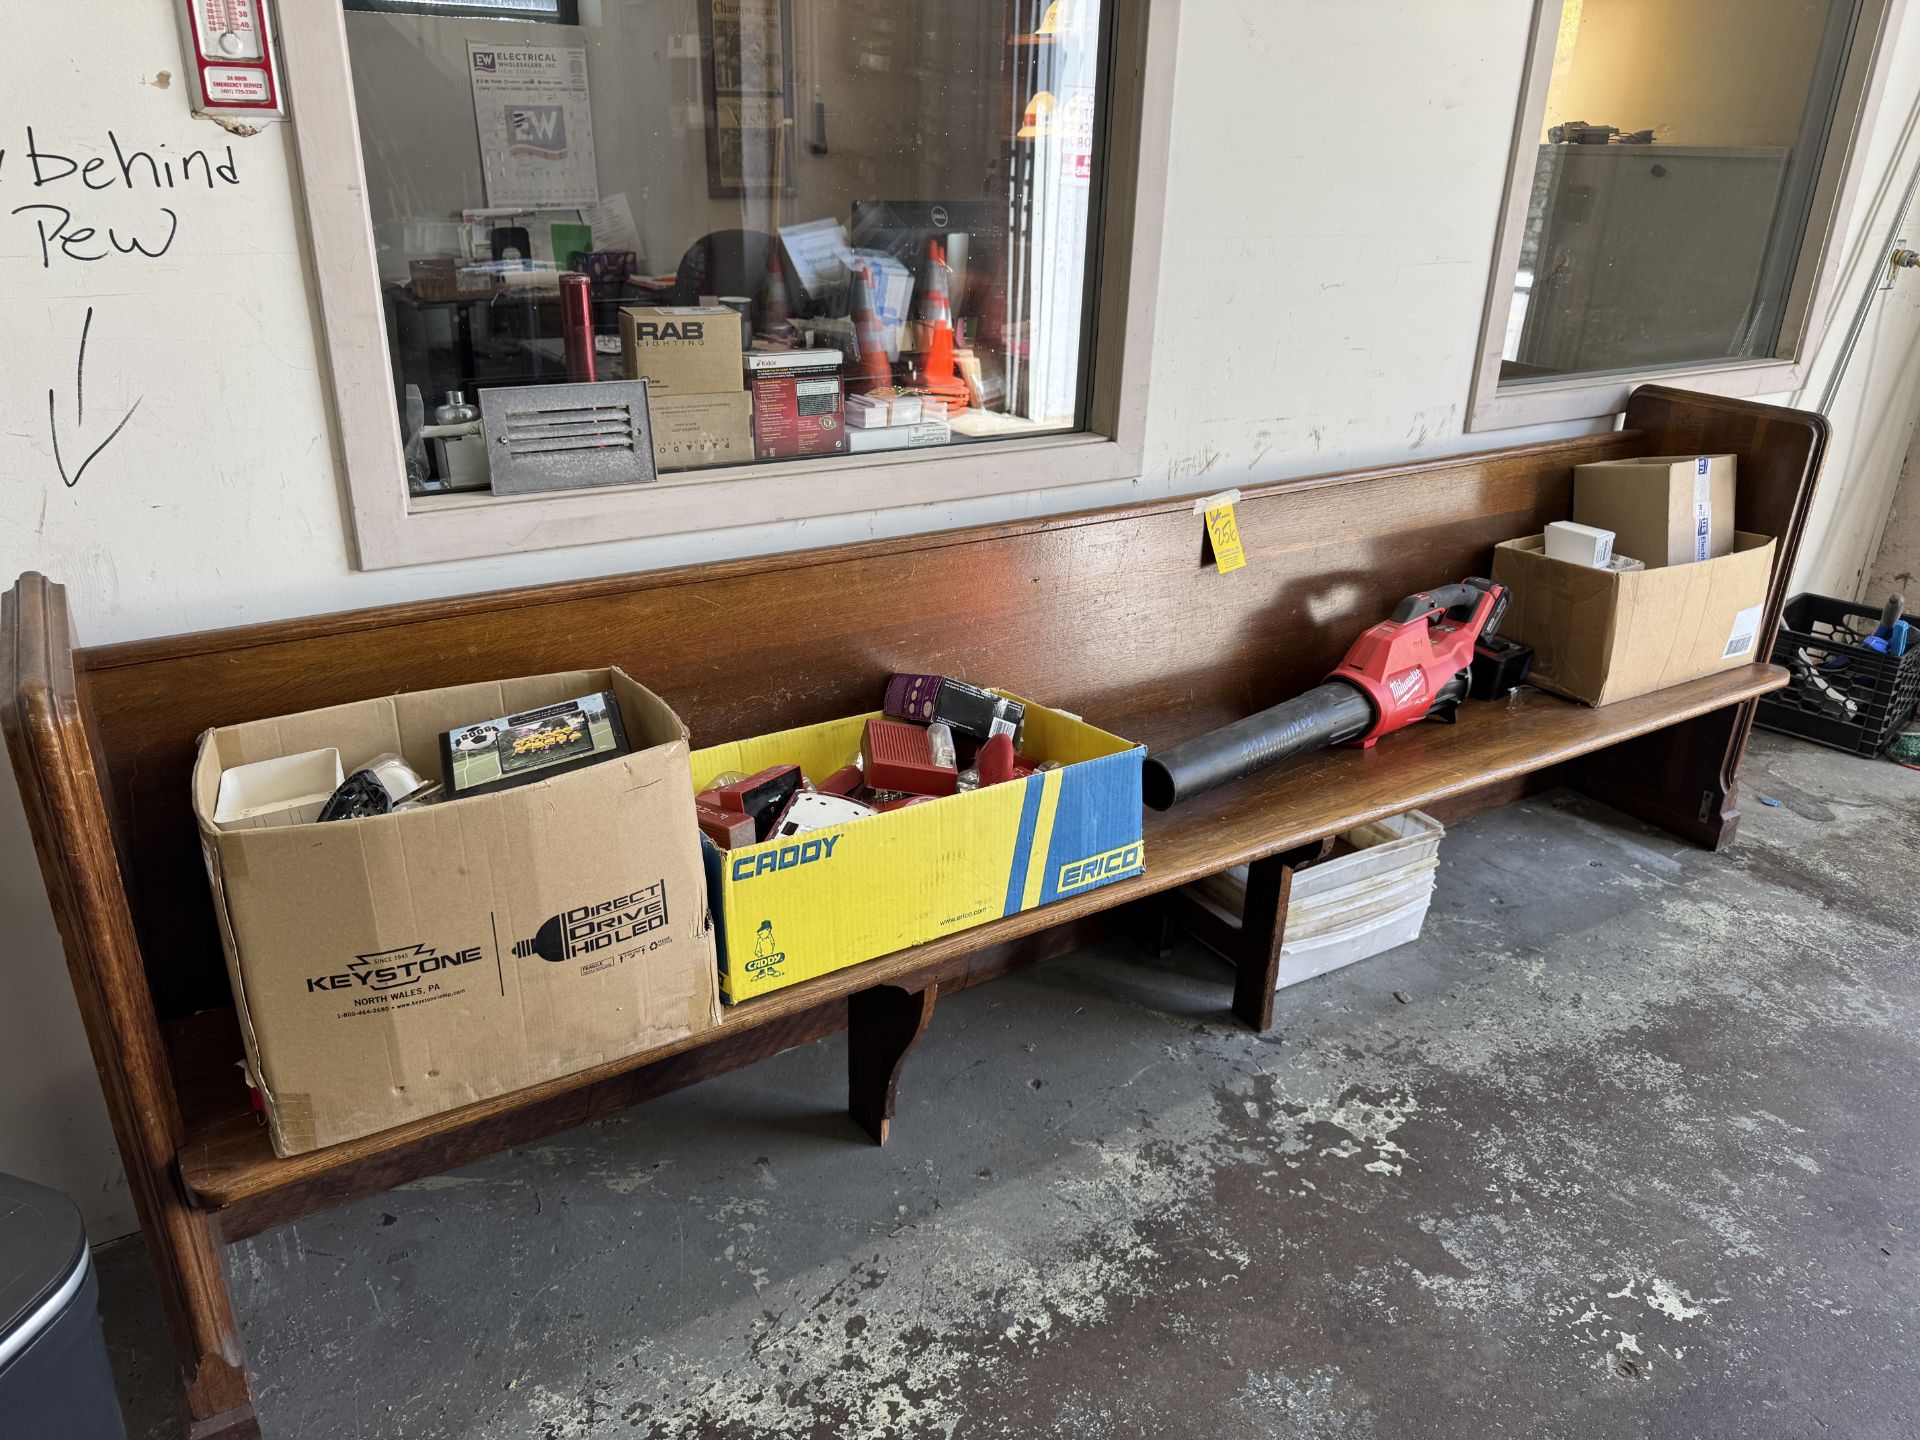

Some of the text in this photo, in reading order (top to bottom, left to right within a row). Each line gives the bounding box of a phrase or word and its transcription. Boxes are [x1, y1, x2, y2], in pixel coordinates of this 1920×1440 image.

[475, 54, 493, 66] EW
[497, 52, 558, 62] ELECTRICAL
[513, 111, 558, 141] EW
[26, 126, 240, 190] behind
[11, 204, 177, 268] Pew
[636, 321, 705, 341] RAB
[732, 834, 841, 882] CADDY
[1062, 845, 1139, 887] ERICO
[567, 883, 660, 924] DIRECT
[569, 900, 662, 941] DRIVE
[571, 934, 612, 958] HID
[615, 914, 664, 943] LED
[306, 946, 483, 993] KEYSTONE
[373, 956, 393, 965] SINCE
[747, 953, 781, 970] CADDY
[354, 983, 441, 1007] NORTH WALES, PA
